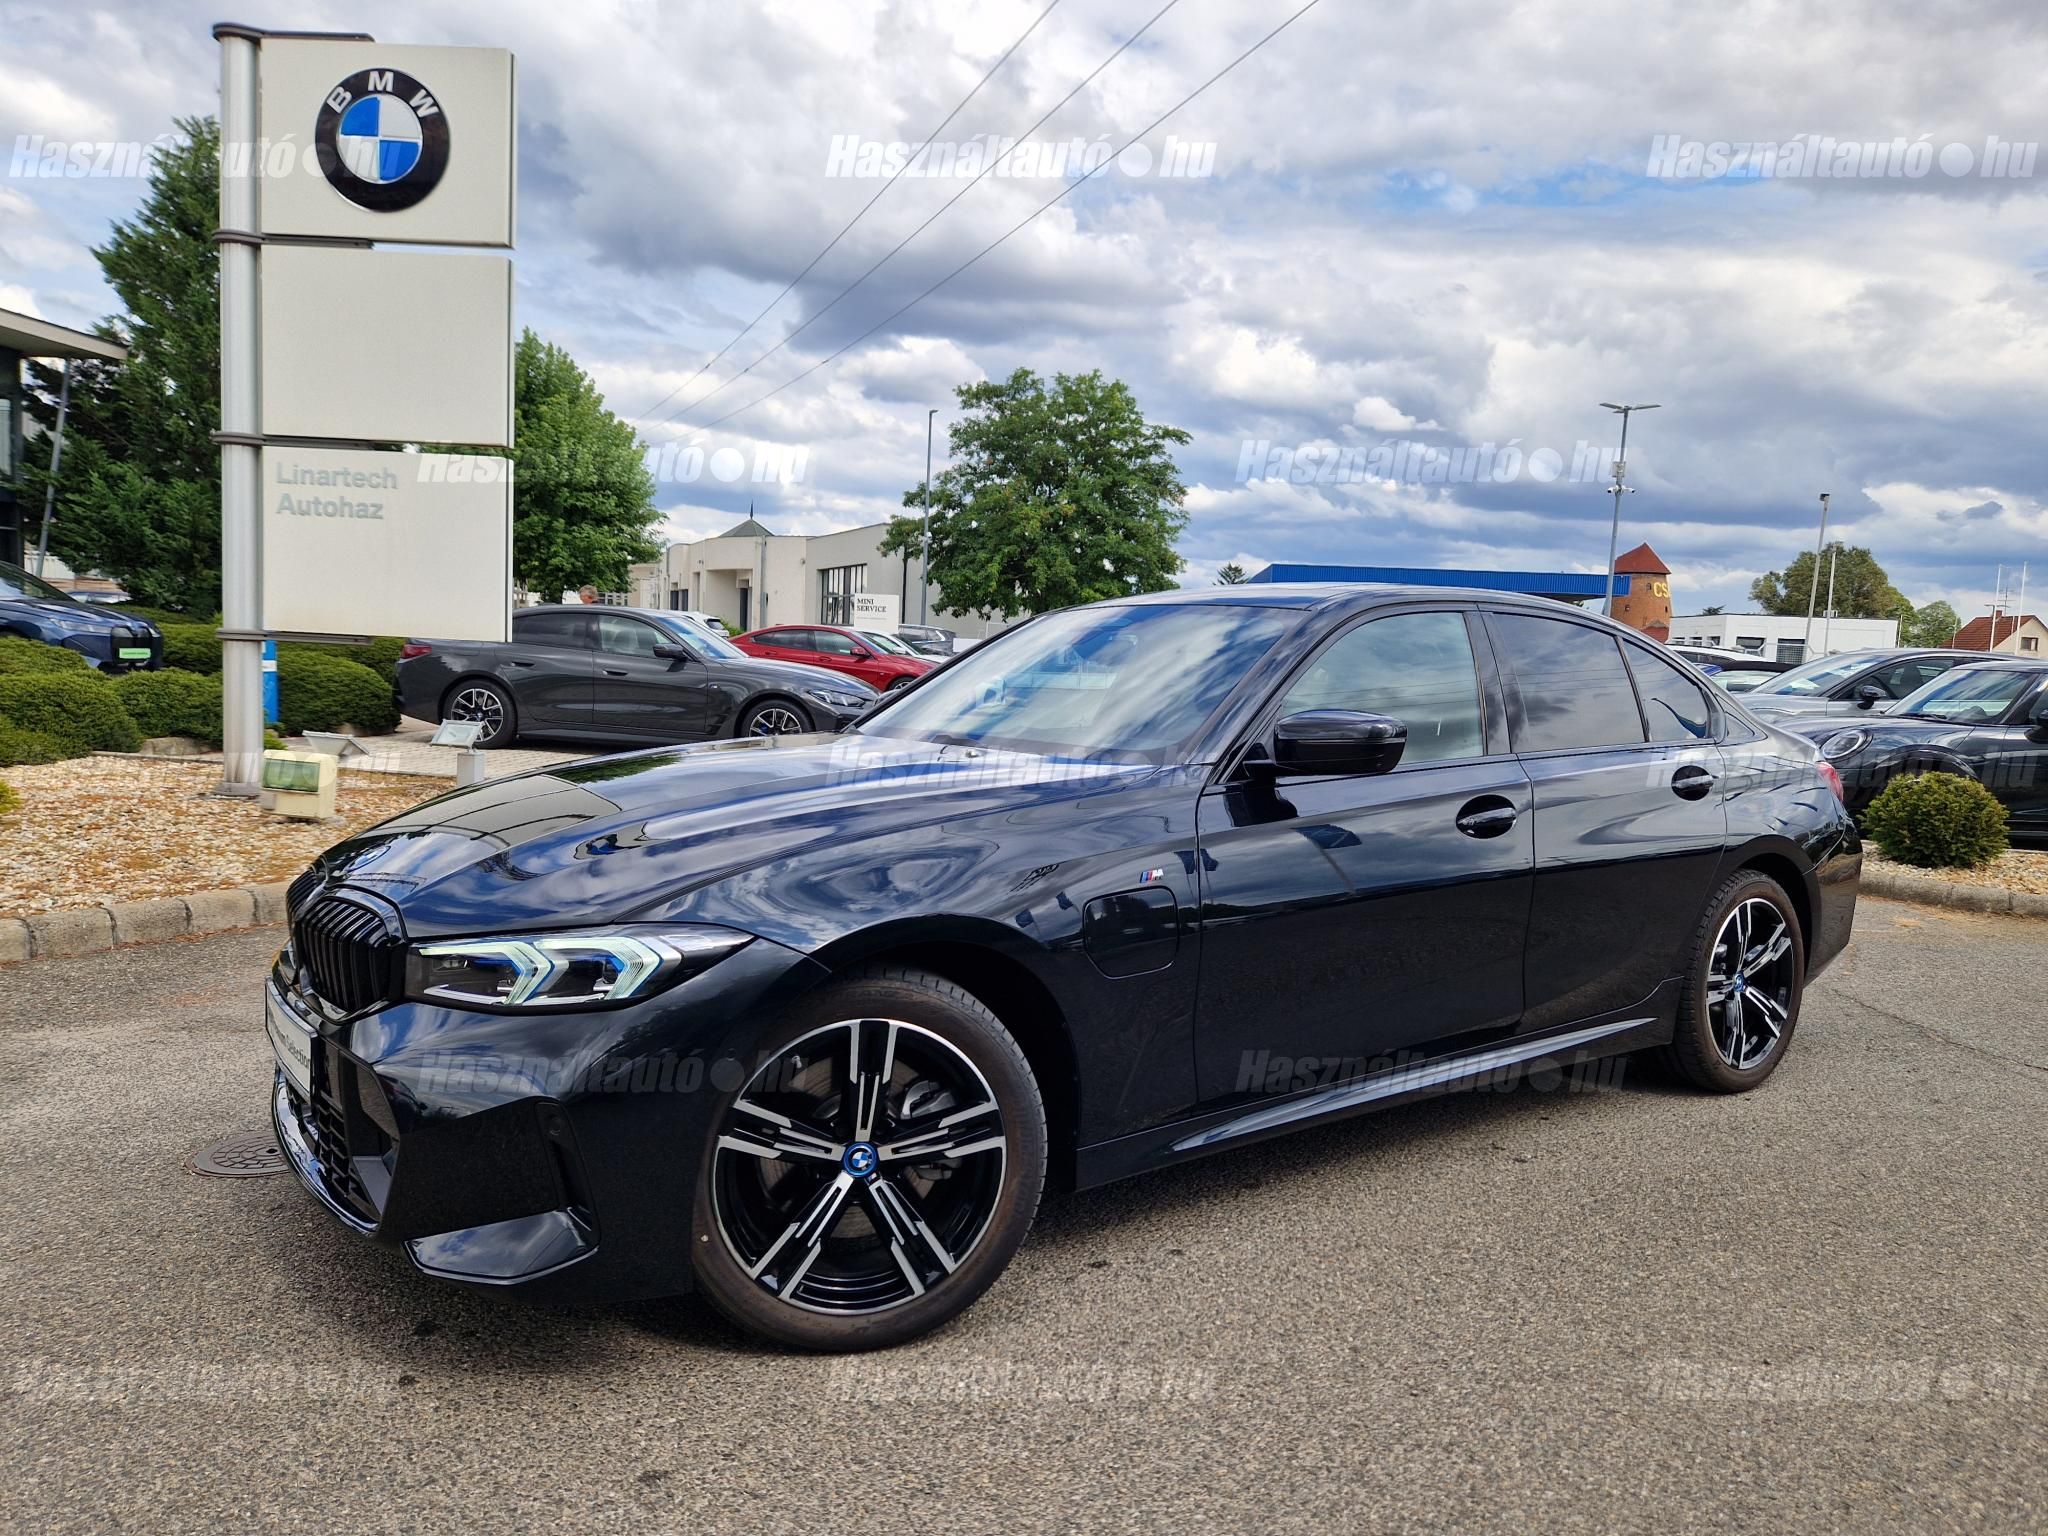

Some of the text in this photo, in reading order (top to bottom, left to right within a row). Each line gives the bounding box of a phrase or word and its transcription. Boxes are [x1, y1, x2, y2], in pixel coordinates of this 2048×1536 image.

[328, 70, 440, 118] BMW
[276, 462, 398, 489] Linartech
[276, 493, 384, 520] Autohaz
[856, 605, 887, 613] SERVICE
